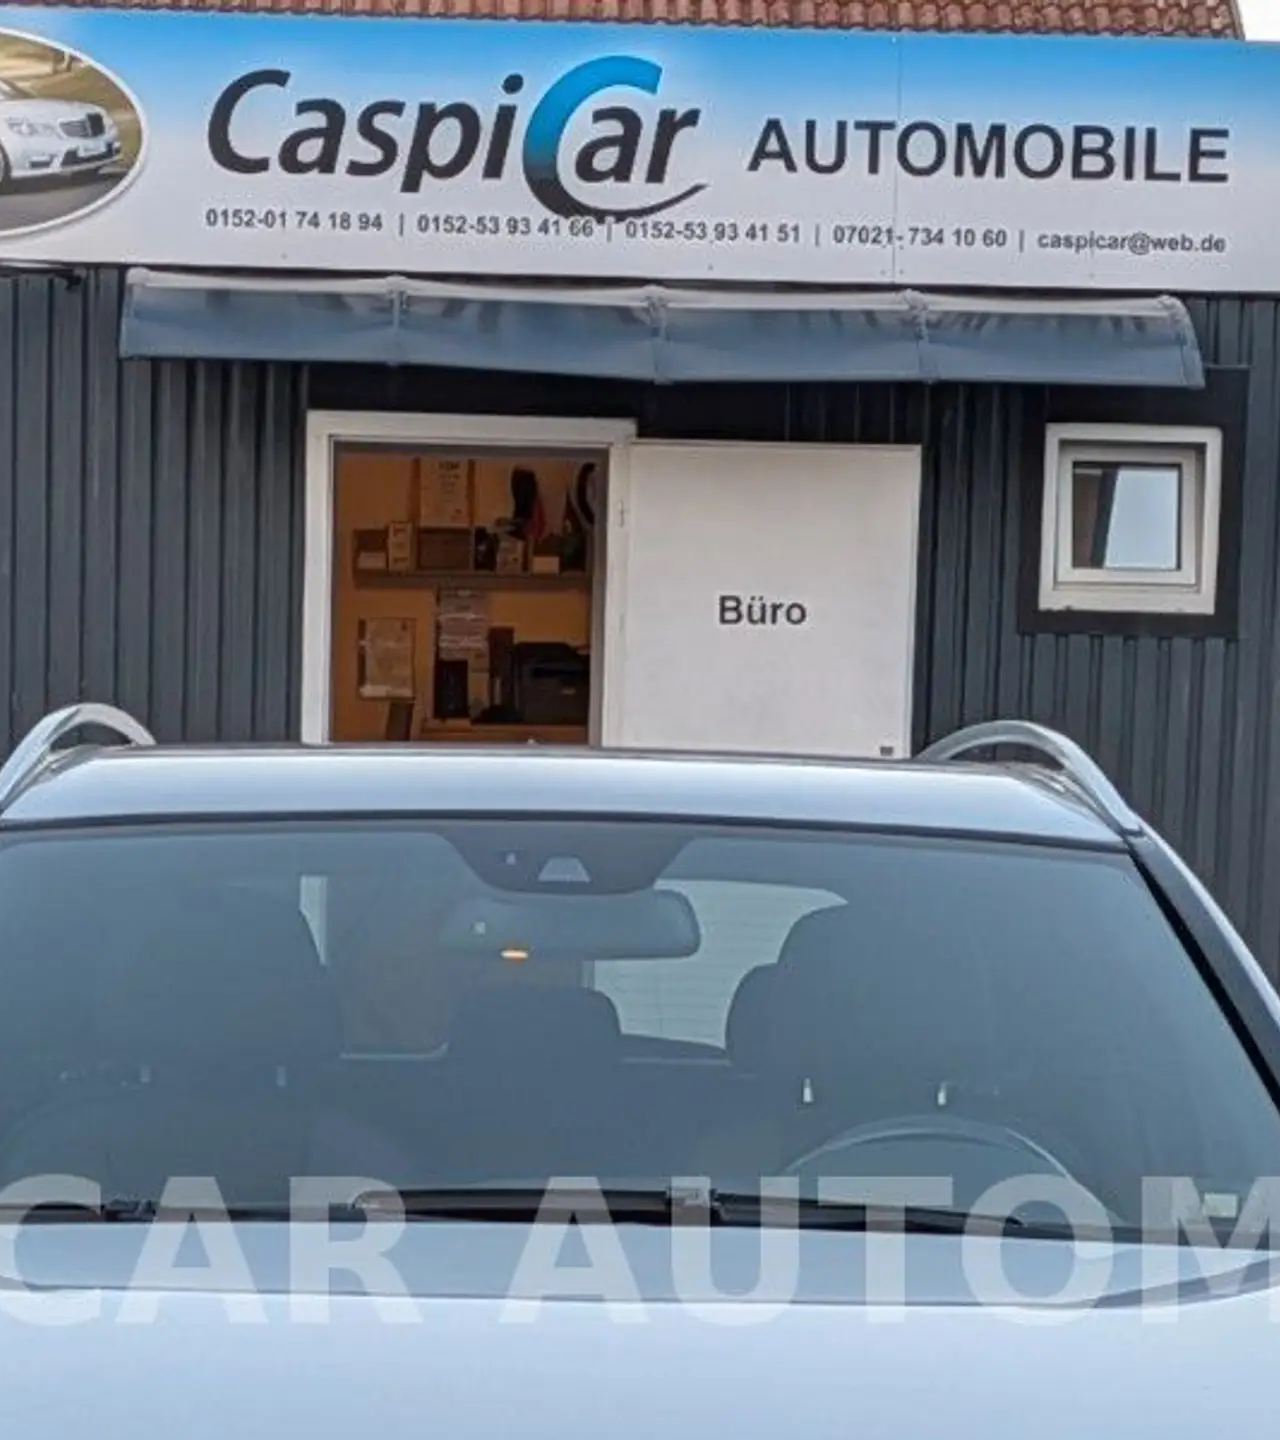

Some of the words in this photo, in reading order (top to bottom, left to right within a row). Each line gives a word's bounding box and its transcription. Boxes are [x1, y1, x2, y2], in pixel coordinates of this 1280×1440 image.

[208, 54, 710, 222] CaspiCar
[747, 118, 1229, 184] AUTOMOBILE
[206, 208, 287, 228] 0152-01
[296, 211, 320, 229] 74
[329, 212, 351, 230] 18
[358, 213, 382, 231] 94
[417, 213, 500, 235] 0152-53
[508, 215, 531, 235] 93
[537, 216, 560, 236] 41
[568, 217, 593, 237] 66
[625, 220, 708, 240] 0152-53
[714, 222, 739, 242] 93
[745, 223, 768, 242] 41
[776, 223, 800, 243] 51
[952, 228, 975, 247] 10
[983, 228, 1007, 248] 60
[1037, 231, 1226, 255] caspicar@web.de
[719, 595, 807, 625] Büro
